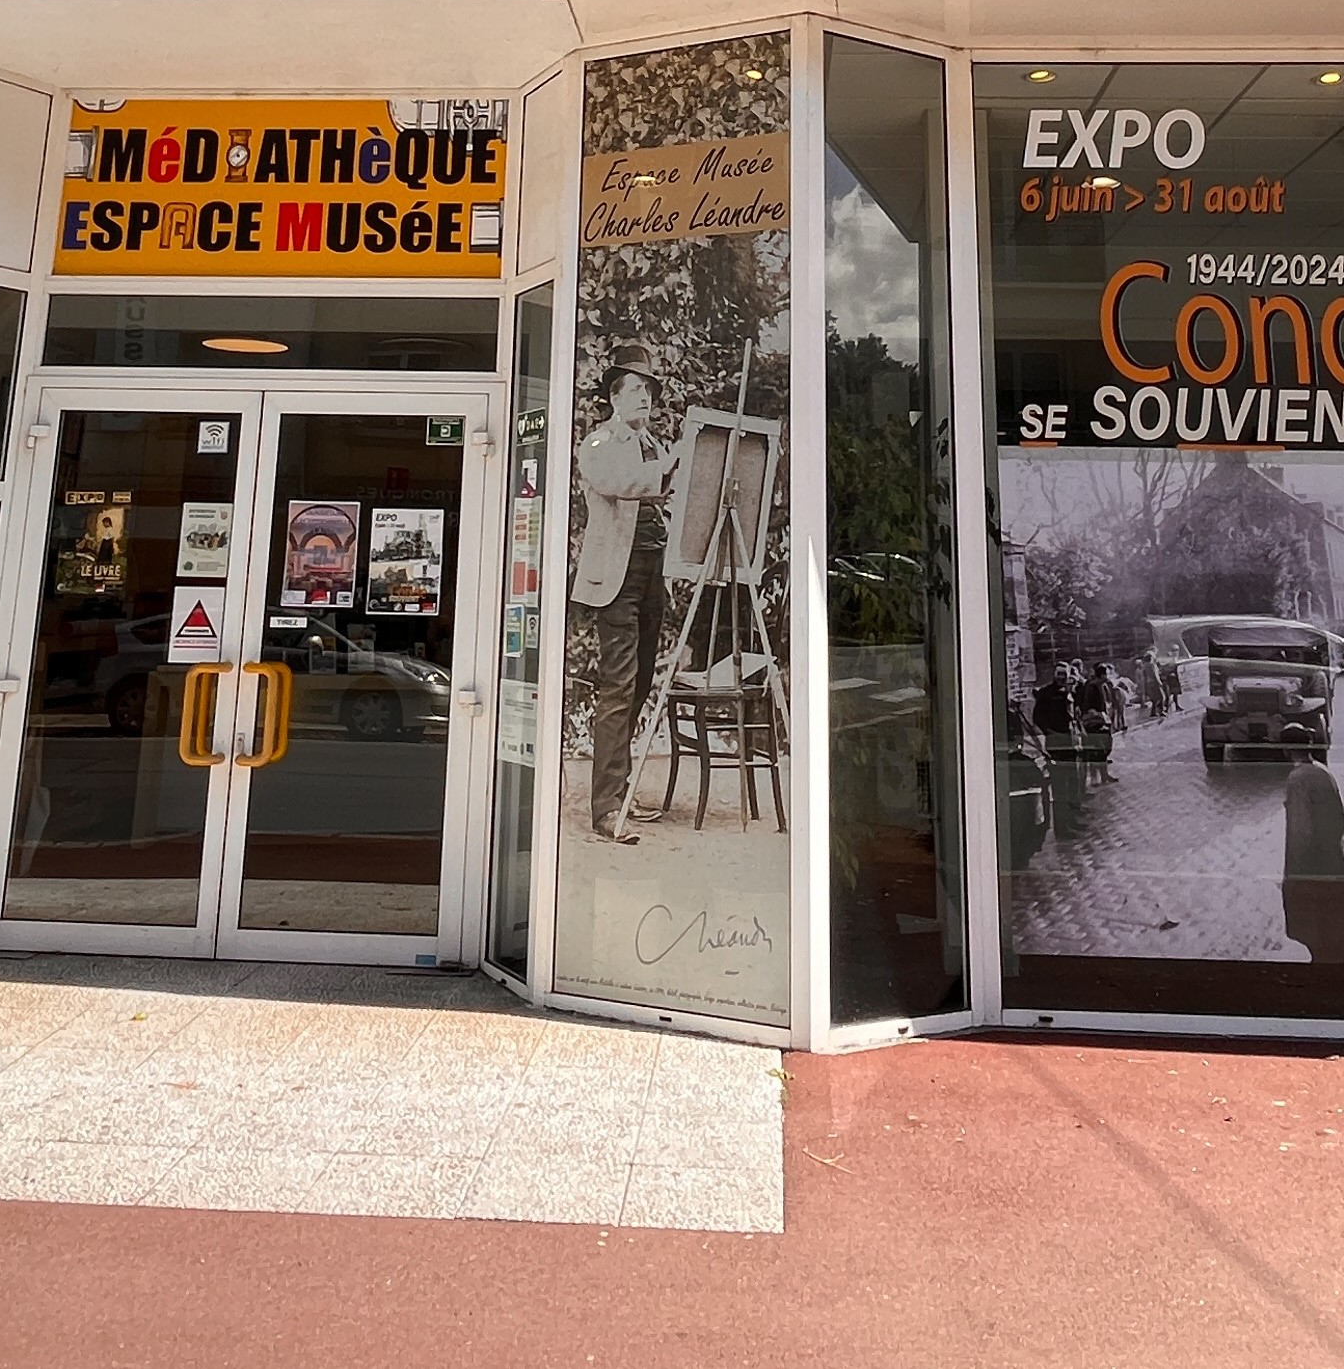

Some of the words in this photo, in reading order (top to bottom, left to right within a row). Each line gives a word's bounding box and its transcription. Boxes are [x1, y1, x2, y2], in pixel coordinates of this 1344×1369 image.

[1022, 108, 1207, 170] EXPO
[600, 158, 681, 203] Espace
[692, 145, 775, 186] Musée
[1019, 178, 1041, 213] 6
[1045, 178, 1115, 221] juin
[1154, 178, 1193, 213] 31
[1204, 177, 1287, 214] août
[61, 200, 264, 253] ESPACE
[583, 196, 680, 243] Charles
[688, 188, 786, 231] Léandre
[1019, 404, 1069, 440] SE
